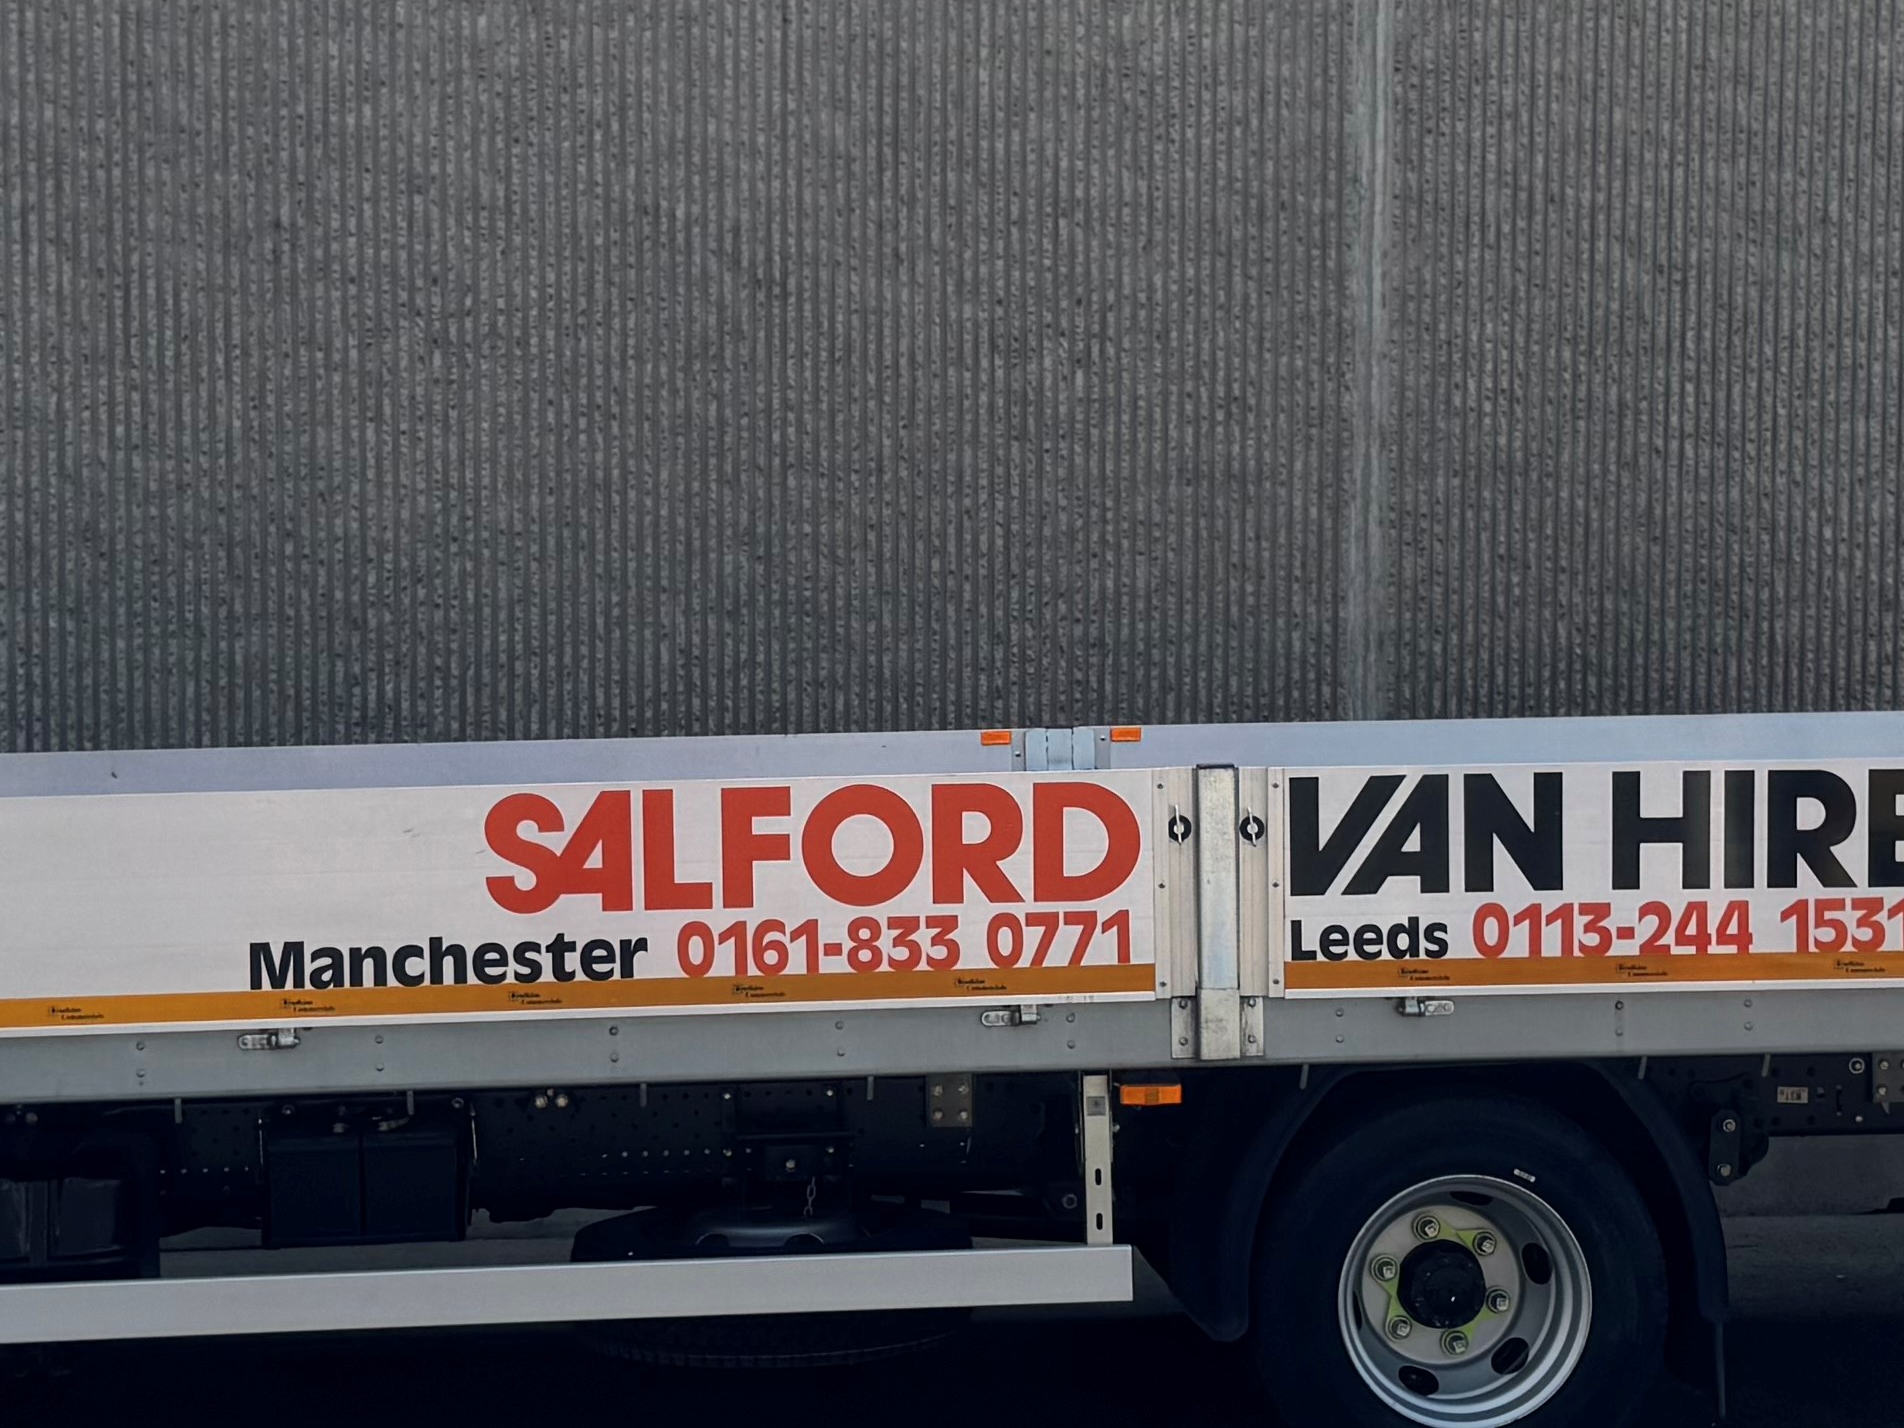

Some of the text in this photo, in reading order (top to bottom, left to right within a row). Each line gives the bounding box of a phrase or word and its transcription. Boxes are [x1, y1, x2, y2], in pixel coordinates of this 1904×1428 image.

[484, 782, 1141, 913] SALFORD
[1288, 772, 1564, 897] VAN
[249, 910, 1132, 991] Manchester 0161-833 0771
[1291, 916, 1449, 962] Leeds
[1472, 900, 1753, 960] 0113-244
